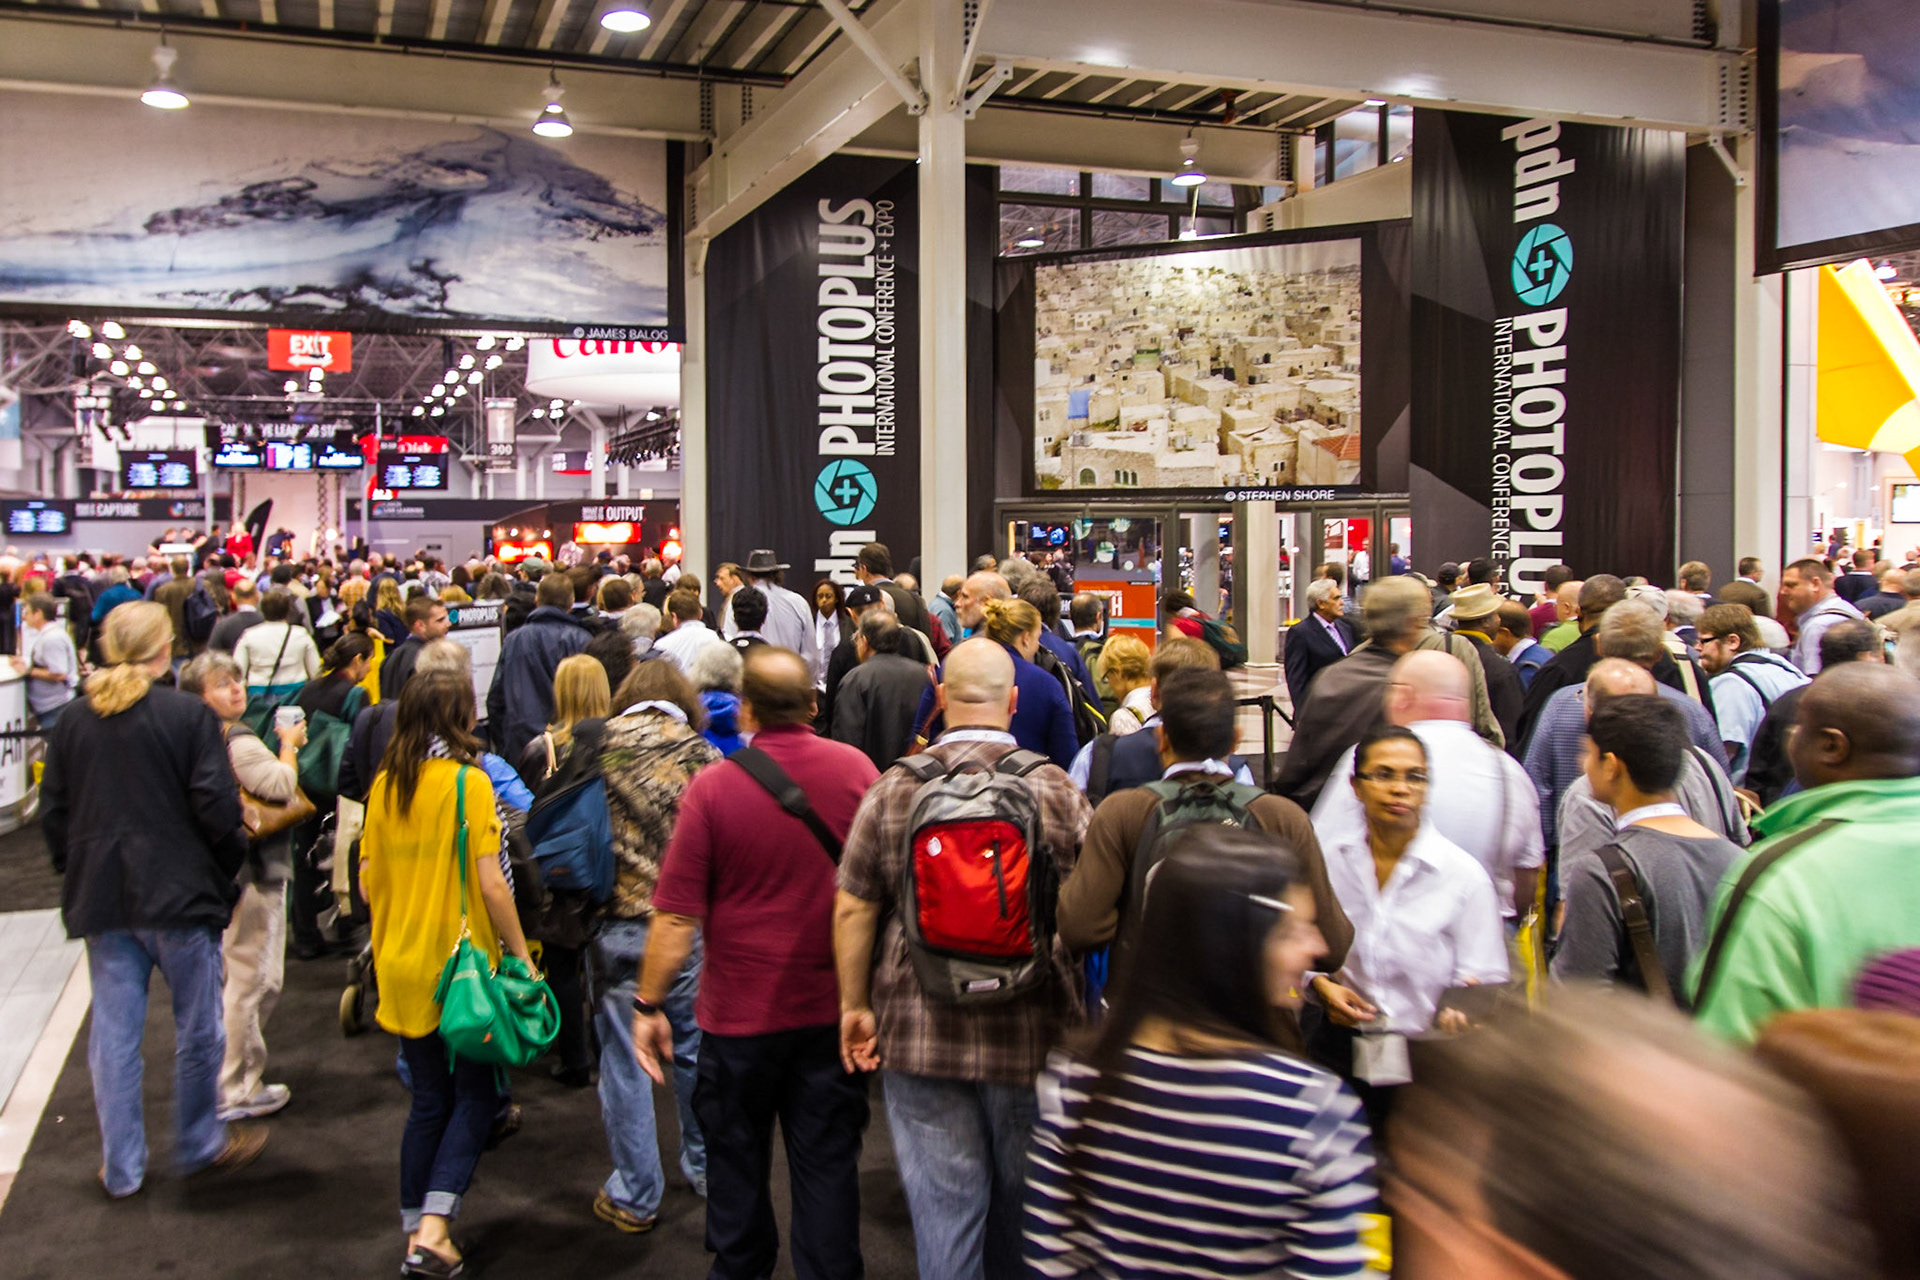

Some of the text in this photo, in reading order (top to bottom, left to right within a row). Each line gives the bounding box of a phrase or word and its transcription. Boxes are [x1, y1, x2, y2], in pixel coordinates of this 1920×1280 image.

[1501, 118, 1575, 224] pdn
[875, 199, 895, 237] EXPO
[817, 198, 877, 456] PHOTOPLUS
[875, 255, 895, 345] CONFERENCE
[289, 334, 332, 355] EXIT
[586, 327, 627, 340] JAMES
[629, 328, 669, 341] BALOG
[875, 346, 895, 456] INTERNATIONAL
[1492, 317, 1513, 450] INTERNATIONAL
[490, 444, 513, 455] 300
[1508, 308, 1568, 602] PHOTOPLU
[96, 503, 140, 517] CAPTURE
[606, 506, 644, 522] OUTPUT
[1238, 490, 1292, 501] STEPHEN
[1293, 489, 1336, 500] SHORE
[1491, 453, 1511, 560] CONFERENCE
[814, 530, 877, 587] dn
